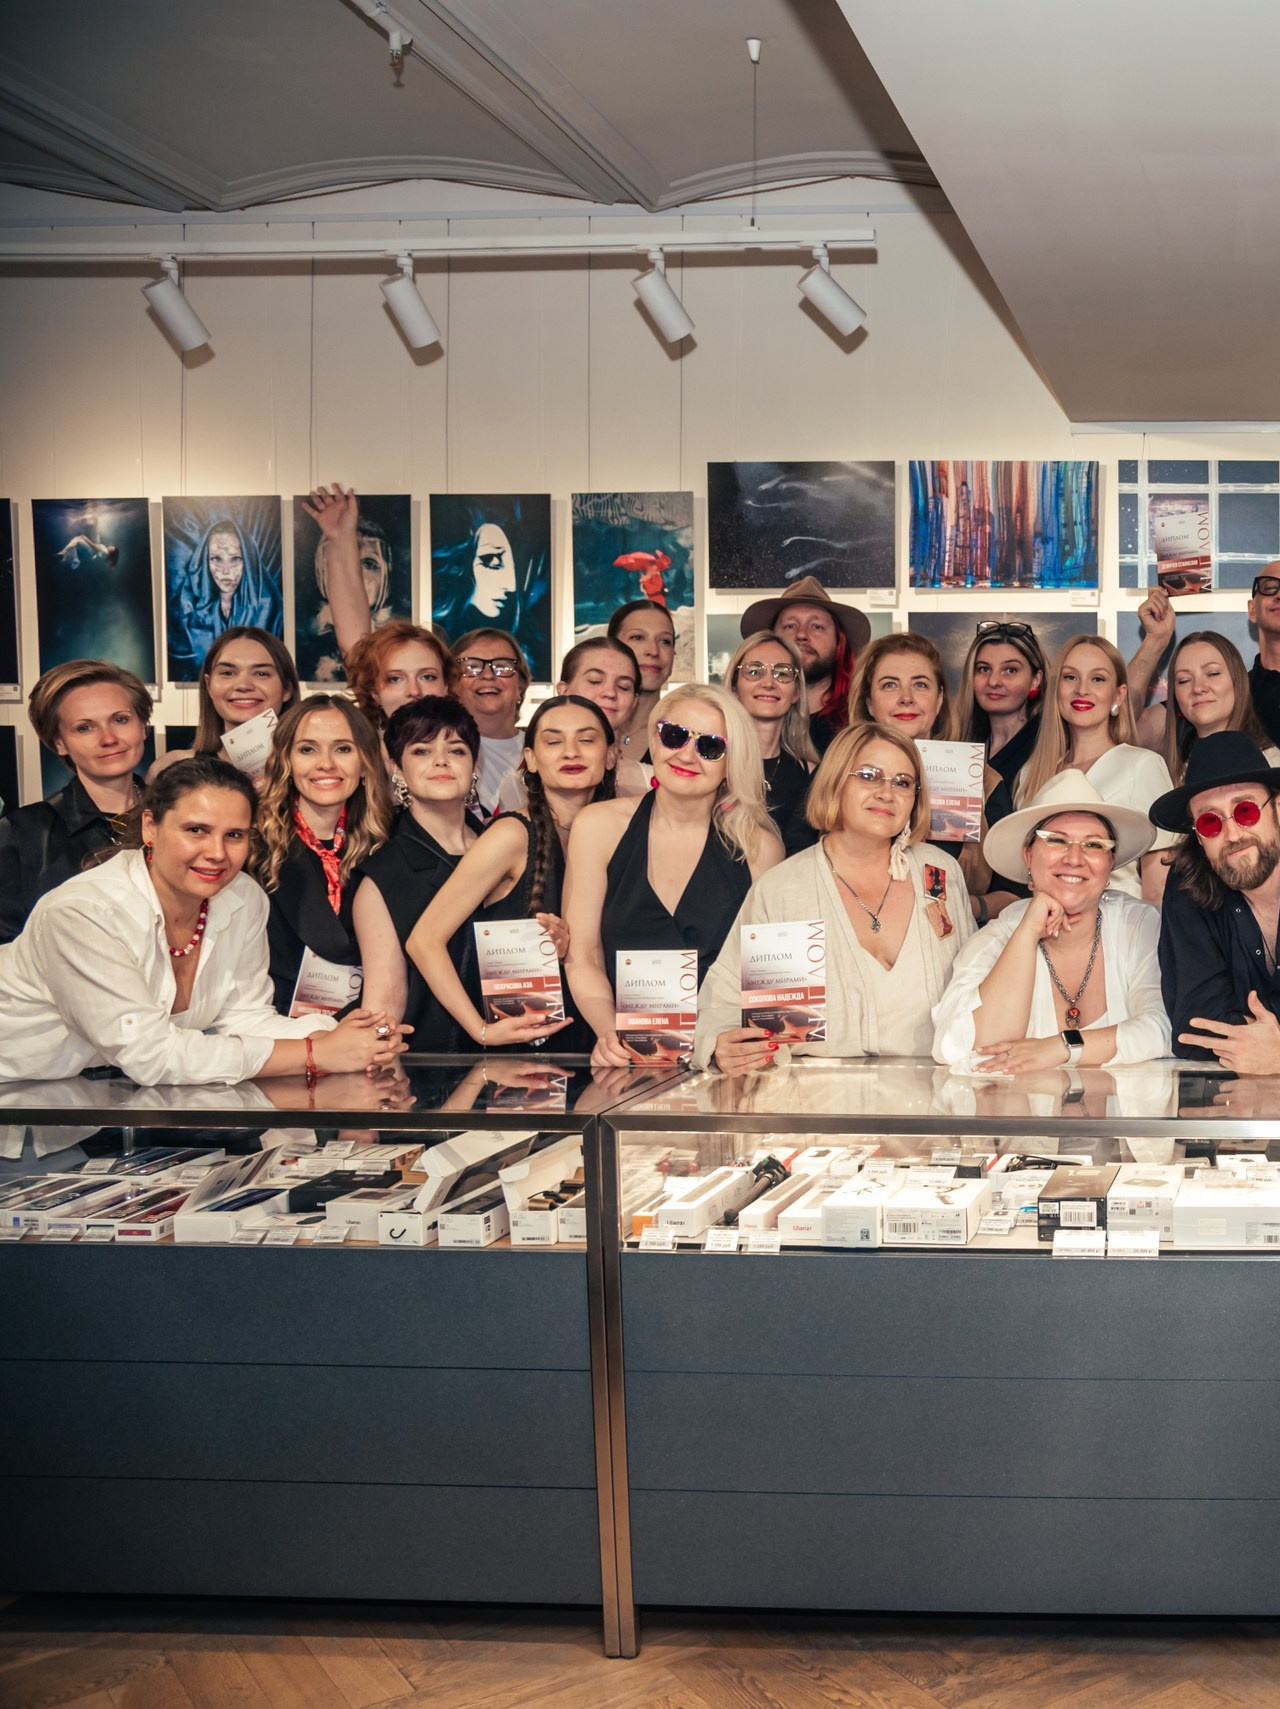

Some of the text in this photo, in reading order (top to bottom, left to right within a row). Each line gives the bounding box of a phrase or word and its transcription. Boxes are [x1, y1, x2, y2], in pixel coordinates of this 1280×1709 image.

[1161, 534, 1189, 543] ДИПЛОМ
[237, 743, 265, 761] ДИПЛОМ
[926, 765, 957, 773] ИПЛОМ
[485, 946, 526, 956] ДИПЛОМ
[749, 952, 793, 963] ДИПЛОМ
[306, 971, 340, 983] ДИПЛОМ
[624, 979, 666, 987] ДИПЛОМ
[776, 992, 805, 1001] НАДЕЖДА
[652, 1017, 669, 1025] ЕЛЕНА
